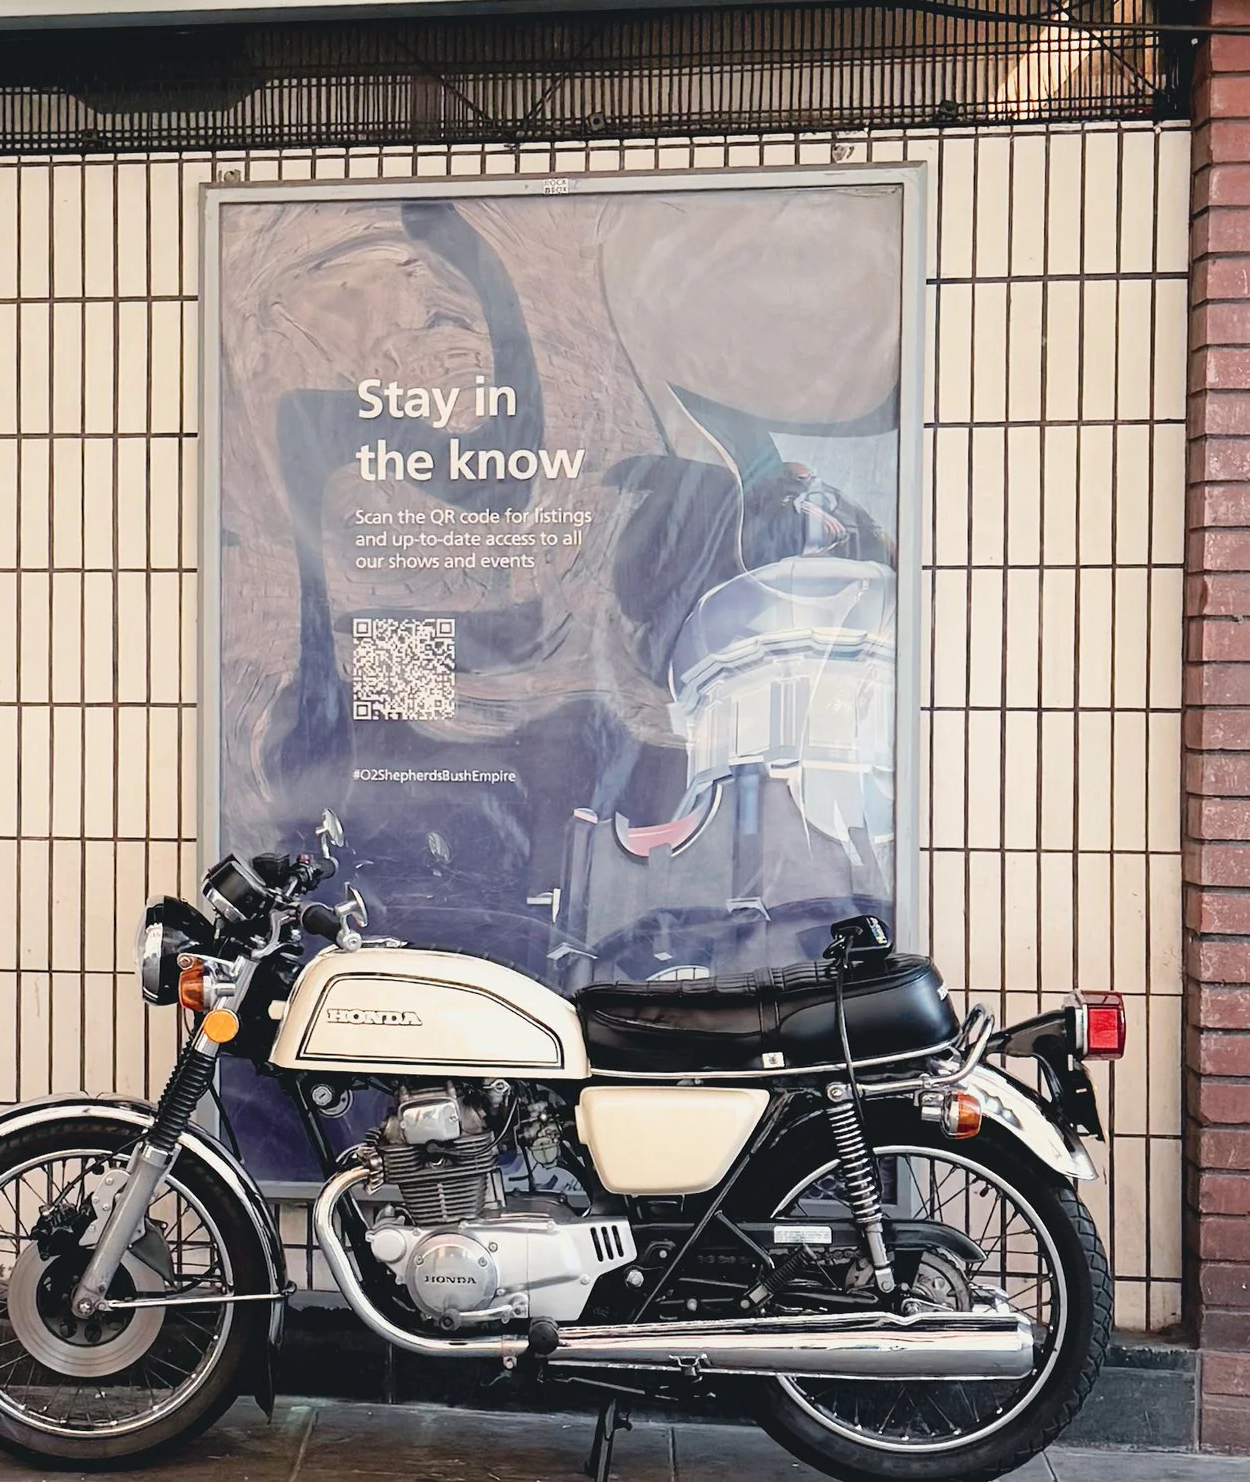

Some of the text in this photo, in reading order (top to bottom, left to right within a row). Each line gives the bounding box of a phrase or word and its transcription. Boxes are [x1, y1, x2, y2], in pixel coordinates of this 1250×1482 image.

[357, 375, 517, 429] Stay in
[355, 438, 585, 481] the know
[355, 507, 592, 527] Scan the QR code for listings
[355, 530, 582, 550] and up-to-date access to all
[355, 553, 535, 568] our shows and events
[353, 768, 517, 784] #O2ShepherdsBushEmpire
[326, 1008, 423, 1026] HONDA
[425, 1275, 477, 1284] HONDA
